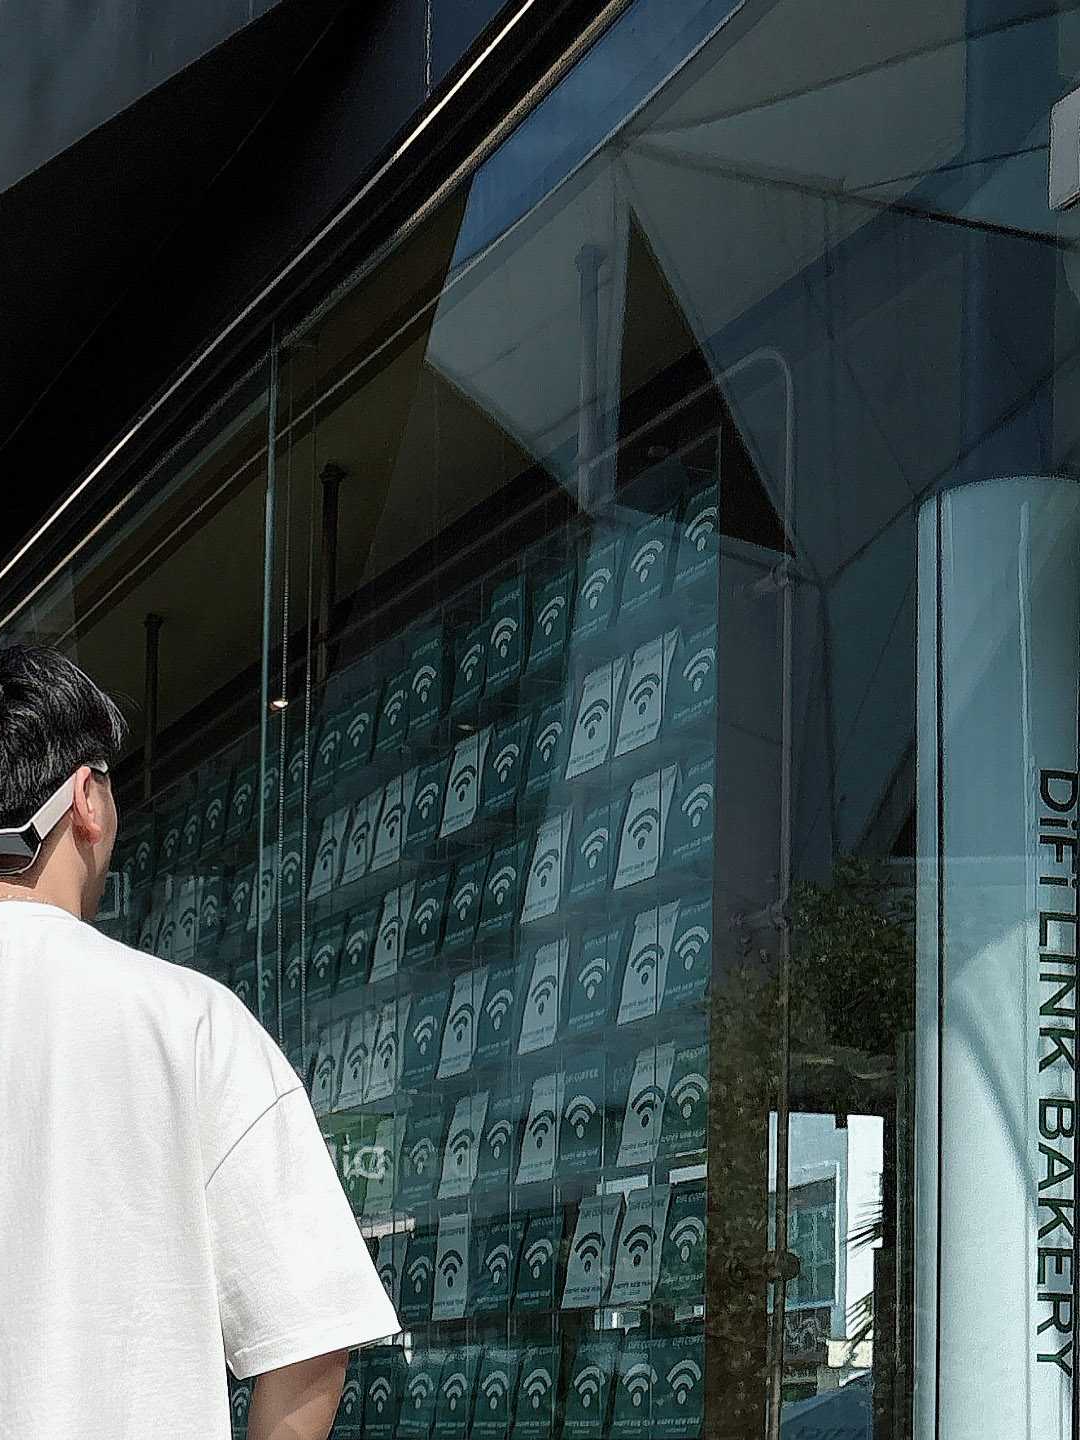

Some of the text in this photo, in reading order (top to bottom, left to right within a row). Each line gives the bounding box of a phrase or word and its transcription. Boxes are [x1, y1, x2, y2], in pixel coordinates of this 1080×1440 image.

[1036, 768, 1079, 1378] DiFi LINK BAKERY
